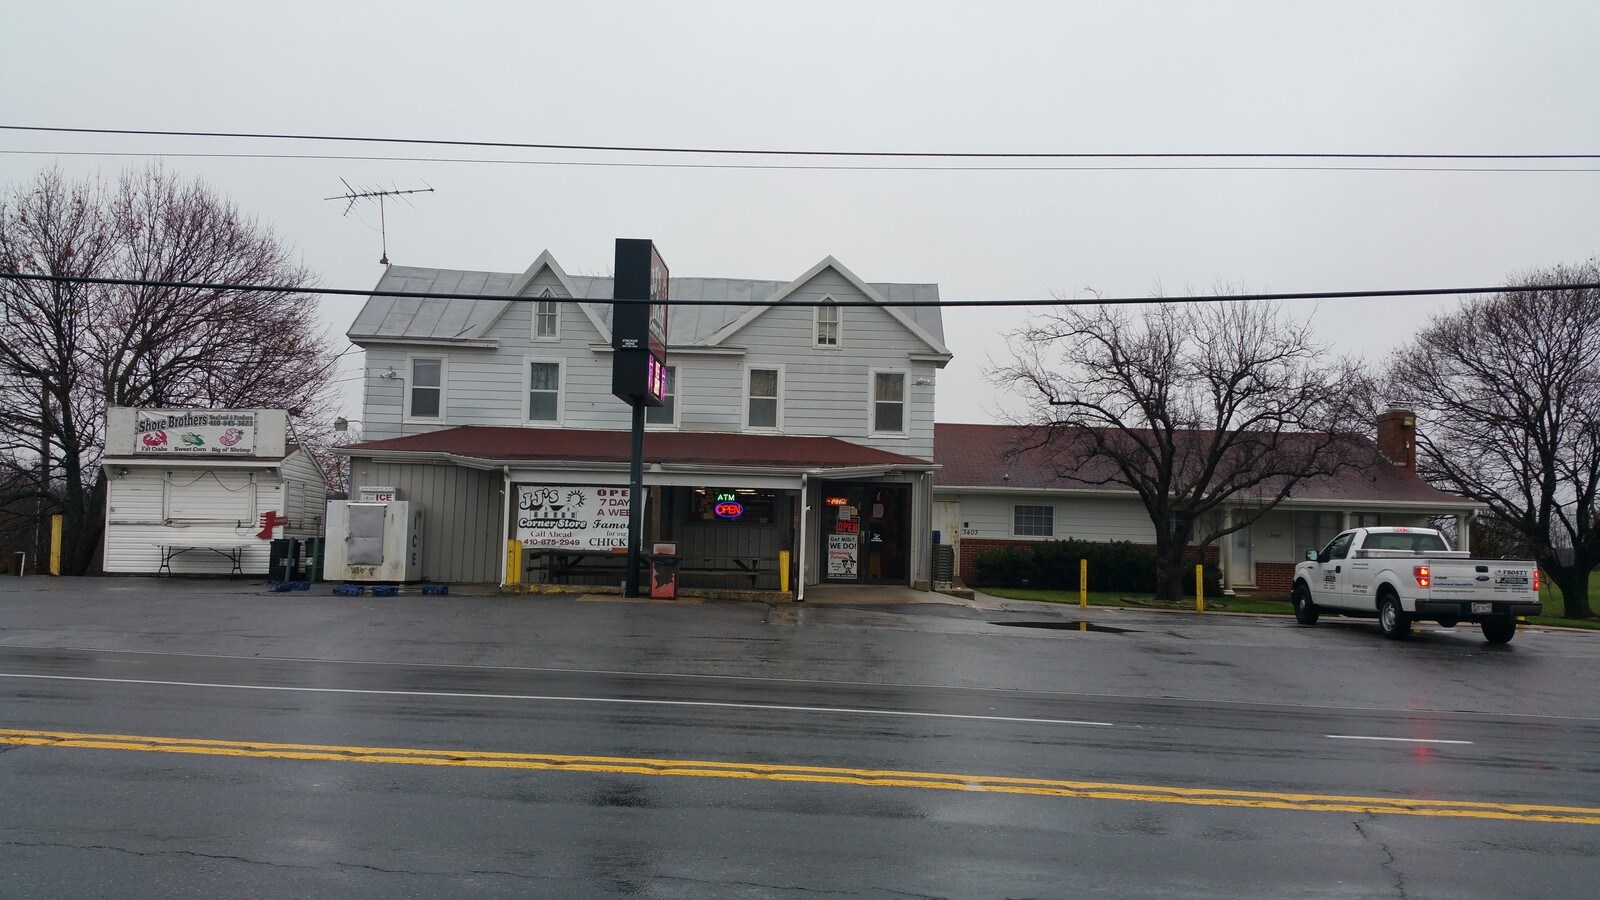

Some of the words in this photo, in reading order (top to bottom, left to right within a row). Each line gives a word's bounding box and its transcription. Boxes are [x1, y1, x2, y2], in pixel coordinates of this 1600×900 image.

[139, 417, 166, 433] Shore
[167, 412, 208, 428] Brothers
[376, 493, 392, 501] ICE
[597, 489, 629, 497] OPE
[717, 493, 735, 501] ATM
[599, 498, 607, 506] 7
[609, 498, 630, 506] DAY
[597, 508, 605, 516] A
[608, 509, 630, 517] WEE
[717, 503, 741, 515] OPEN
[519, 518, 556, 529] Corner
[557, 518, 587, 530] Store
[592, 519, 630, 529] Famo
[838, 522, 858, 533] OPEN
[523, 538, 580, 546] 410-875-2949
[589, 538, 626, 547] CHICK
